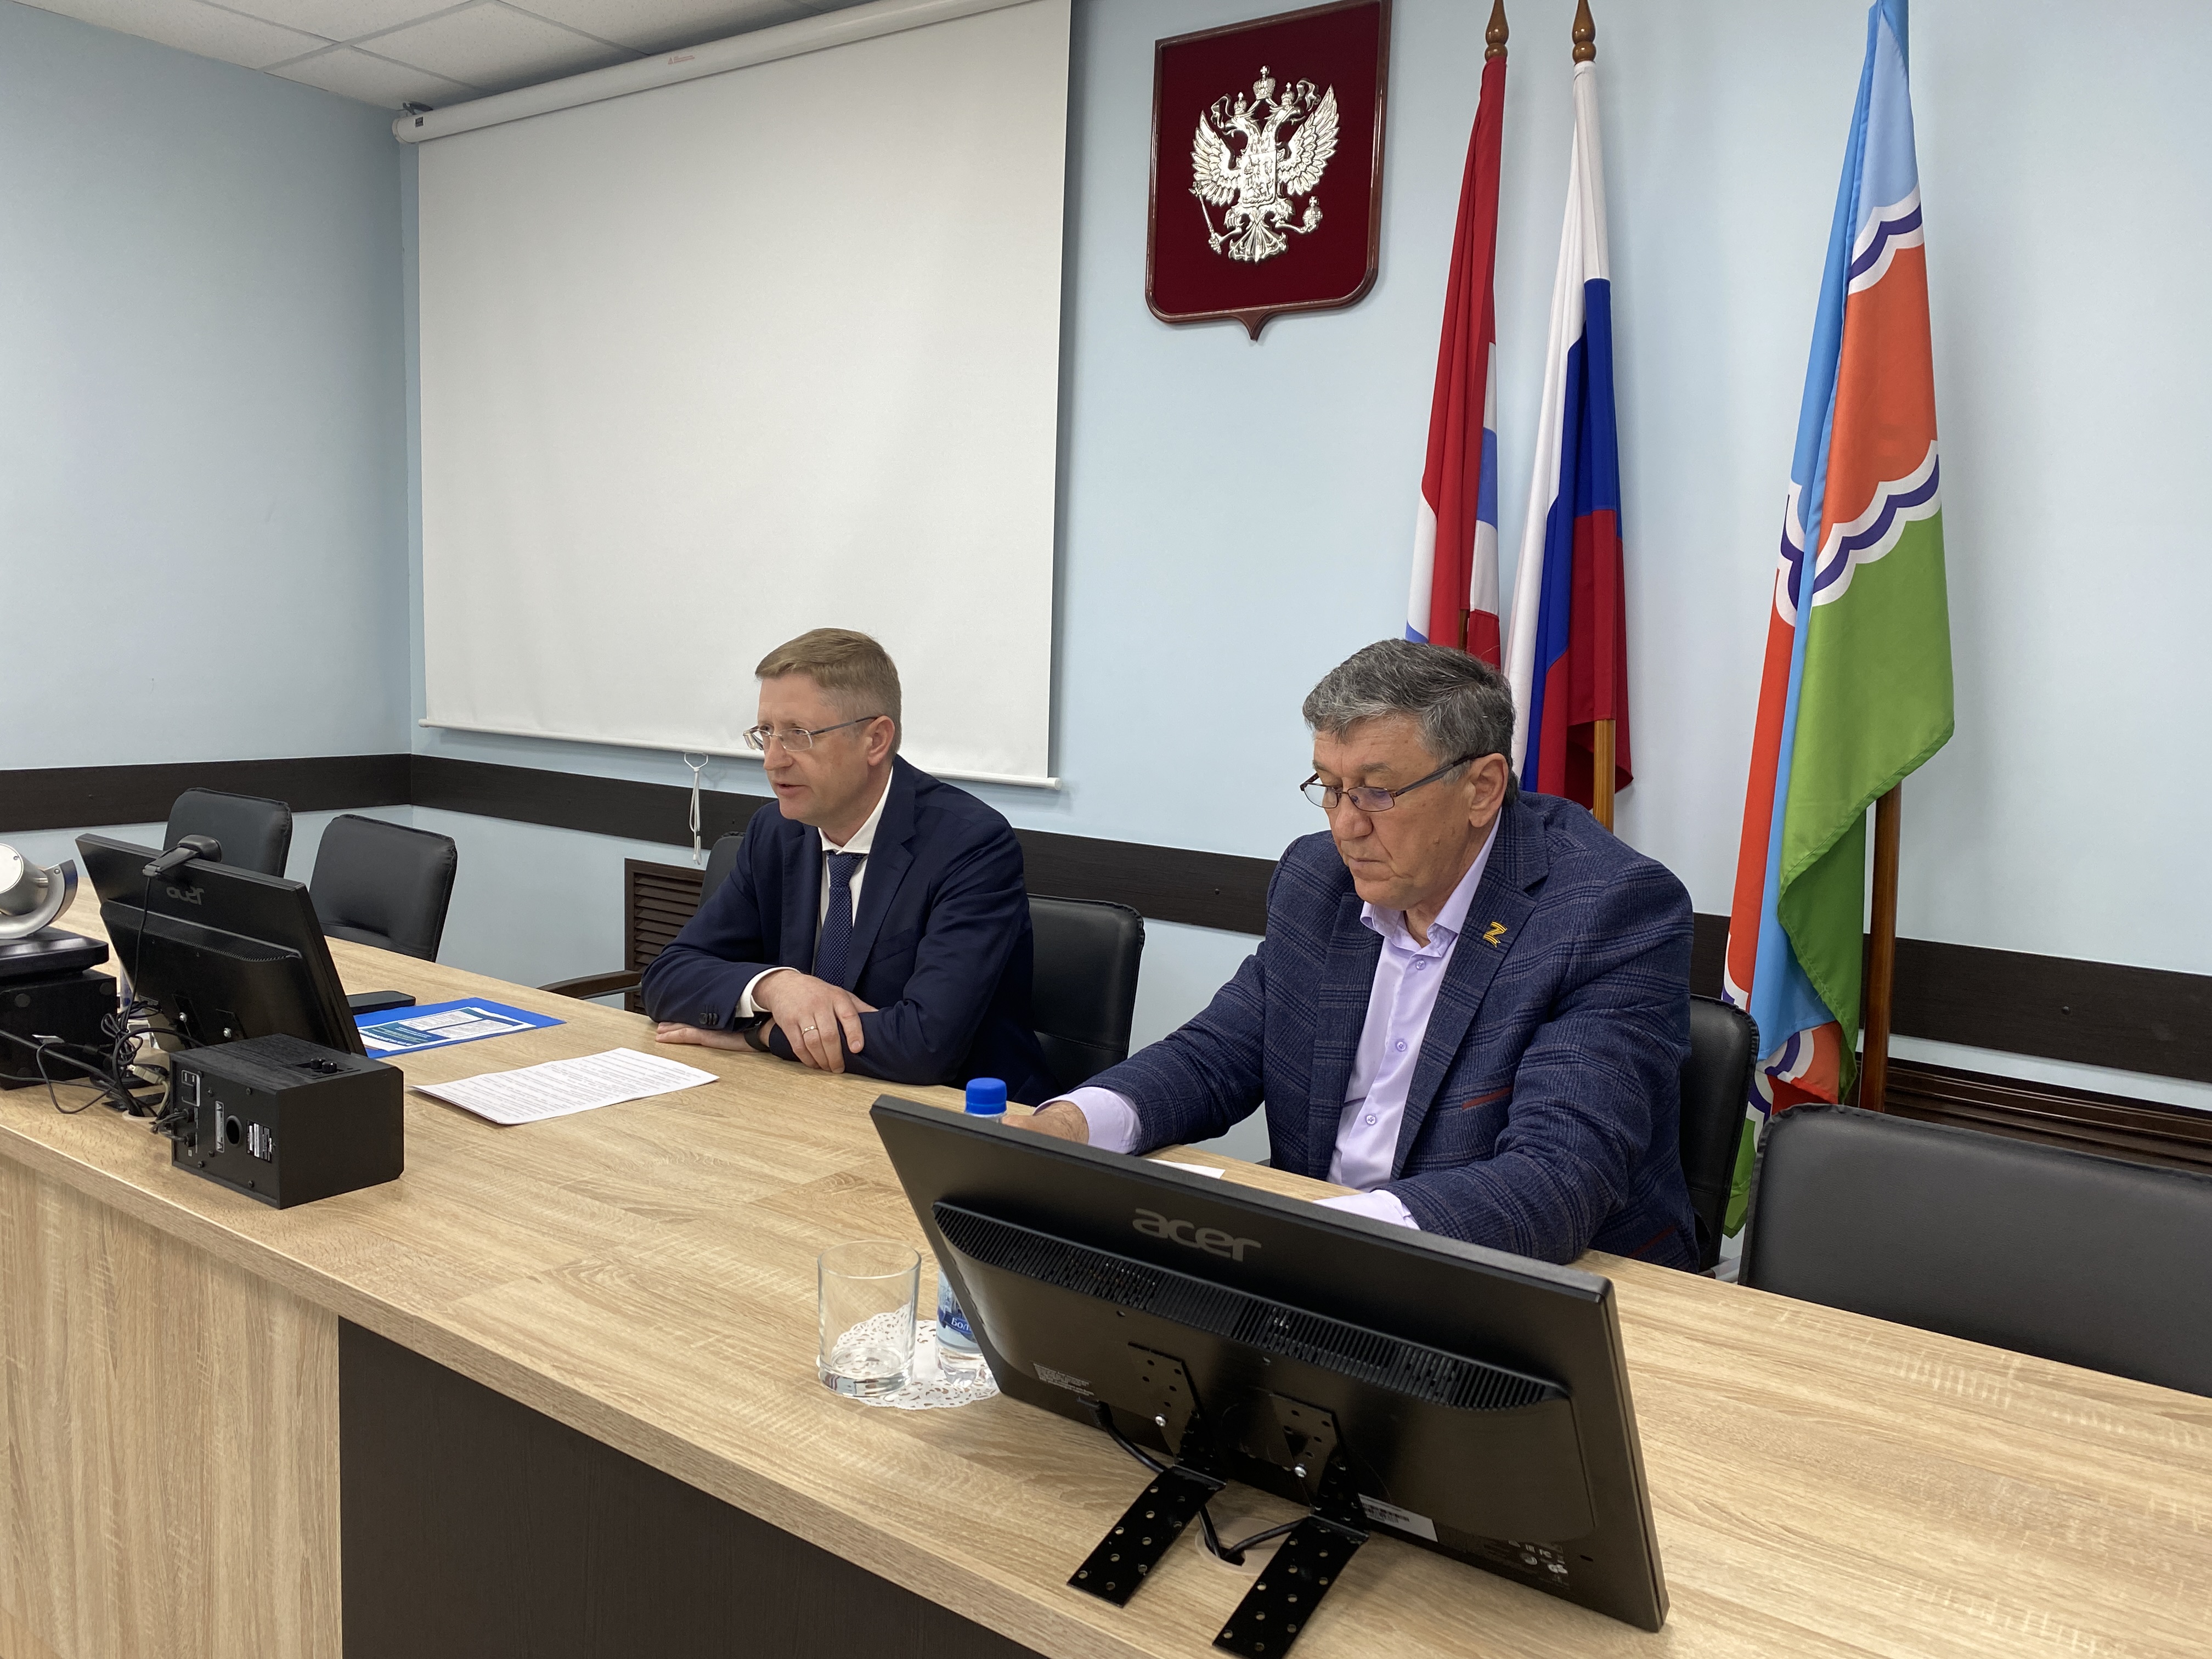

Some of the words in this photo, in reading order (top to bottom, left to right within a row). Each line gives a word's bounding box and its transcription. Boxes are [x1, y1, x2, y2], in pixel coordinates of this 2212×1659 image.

[1483, 921, 1508, 949] Z
[1132, 1207, 1262, 1262] acer
[951, 1317, 970, 1331] Бол
